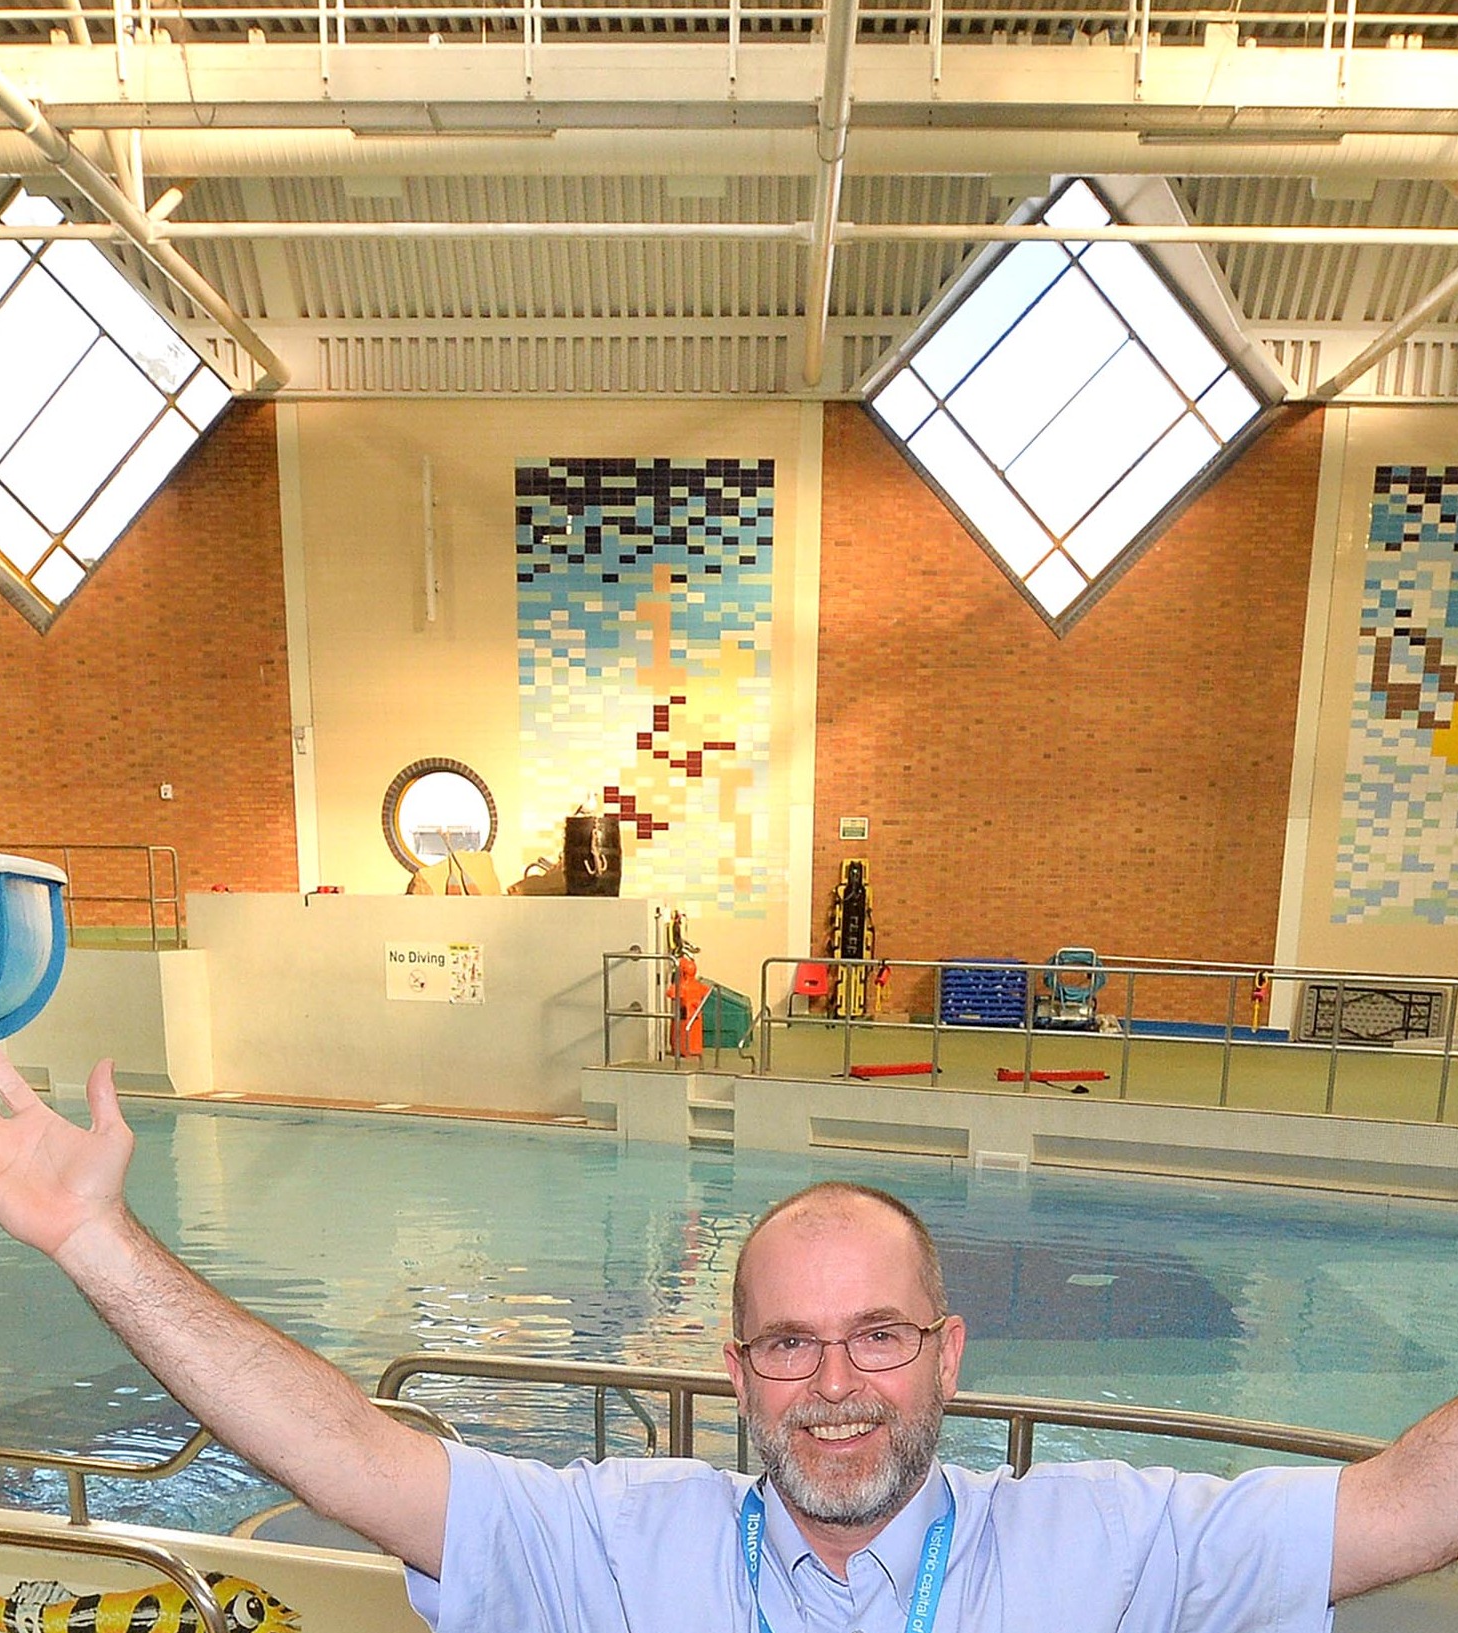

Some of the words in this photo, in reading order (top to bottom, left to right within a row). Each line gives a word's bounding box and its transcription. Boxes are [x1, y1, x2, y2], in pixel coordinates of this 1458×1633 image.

[389, 951, 405, 963] No
[409, 951, 445, 967] Diving
[747, 1512, 761, 1572] COUNCIL
[924, 1525, 946, 1572] historic
[916, 1574, 933, 1617] capital
[912, 1618, 924, 1633] of
